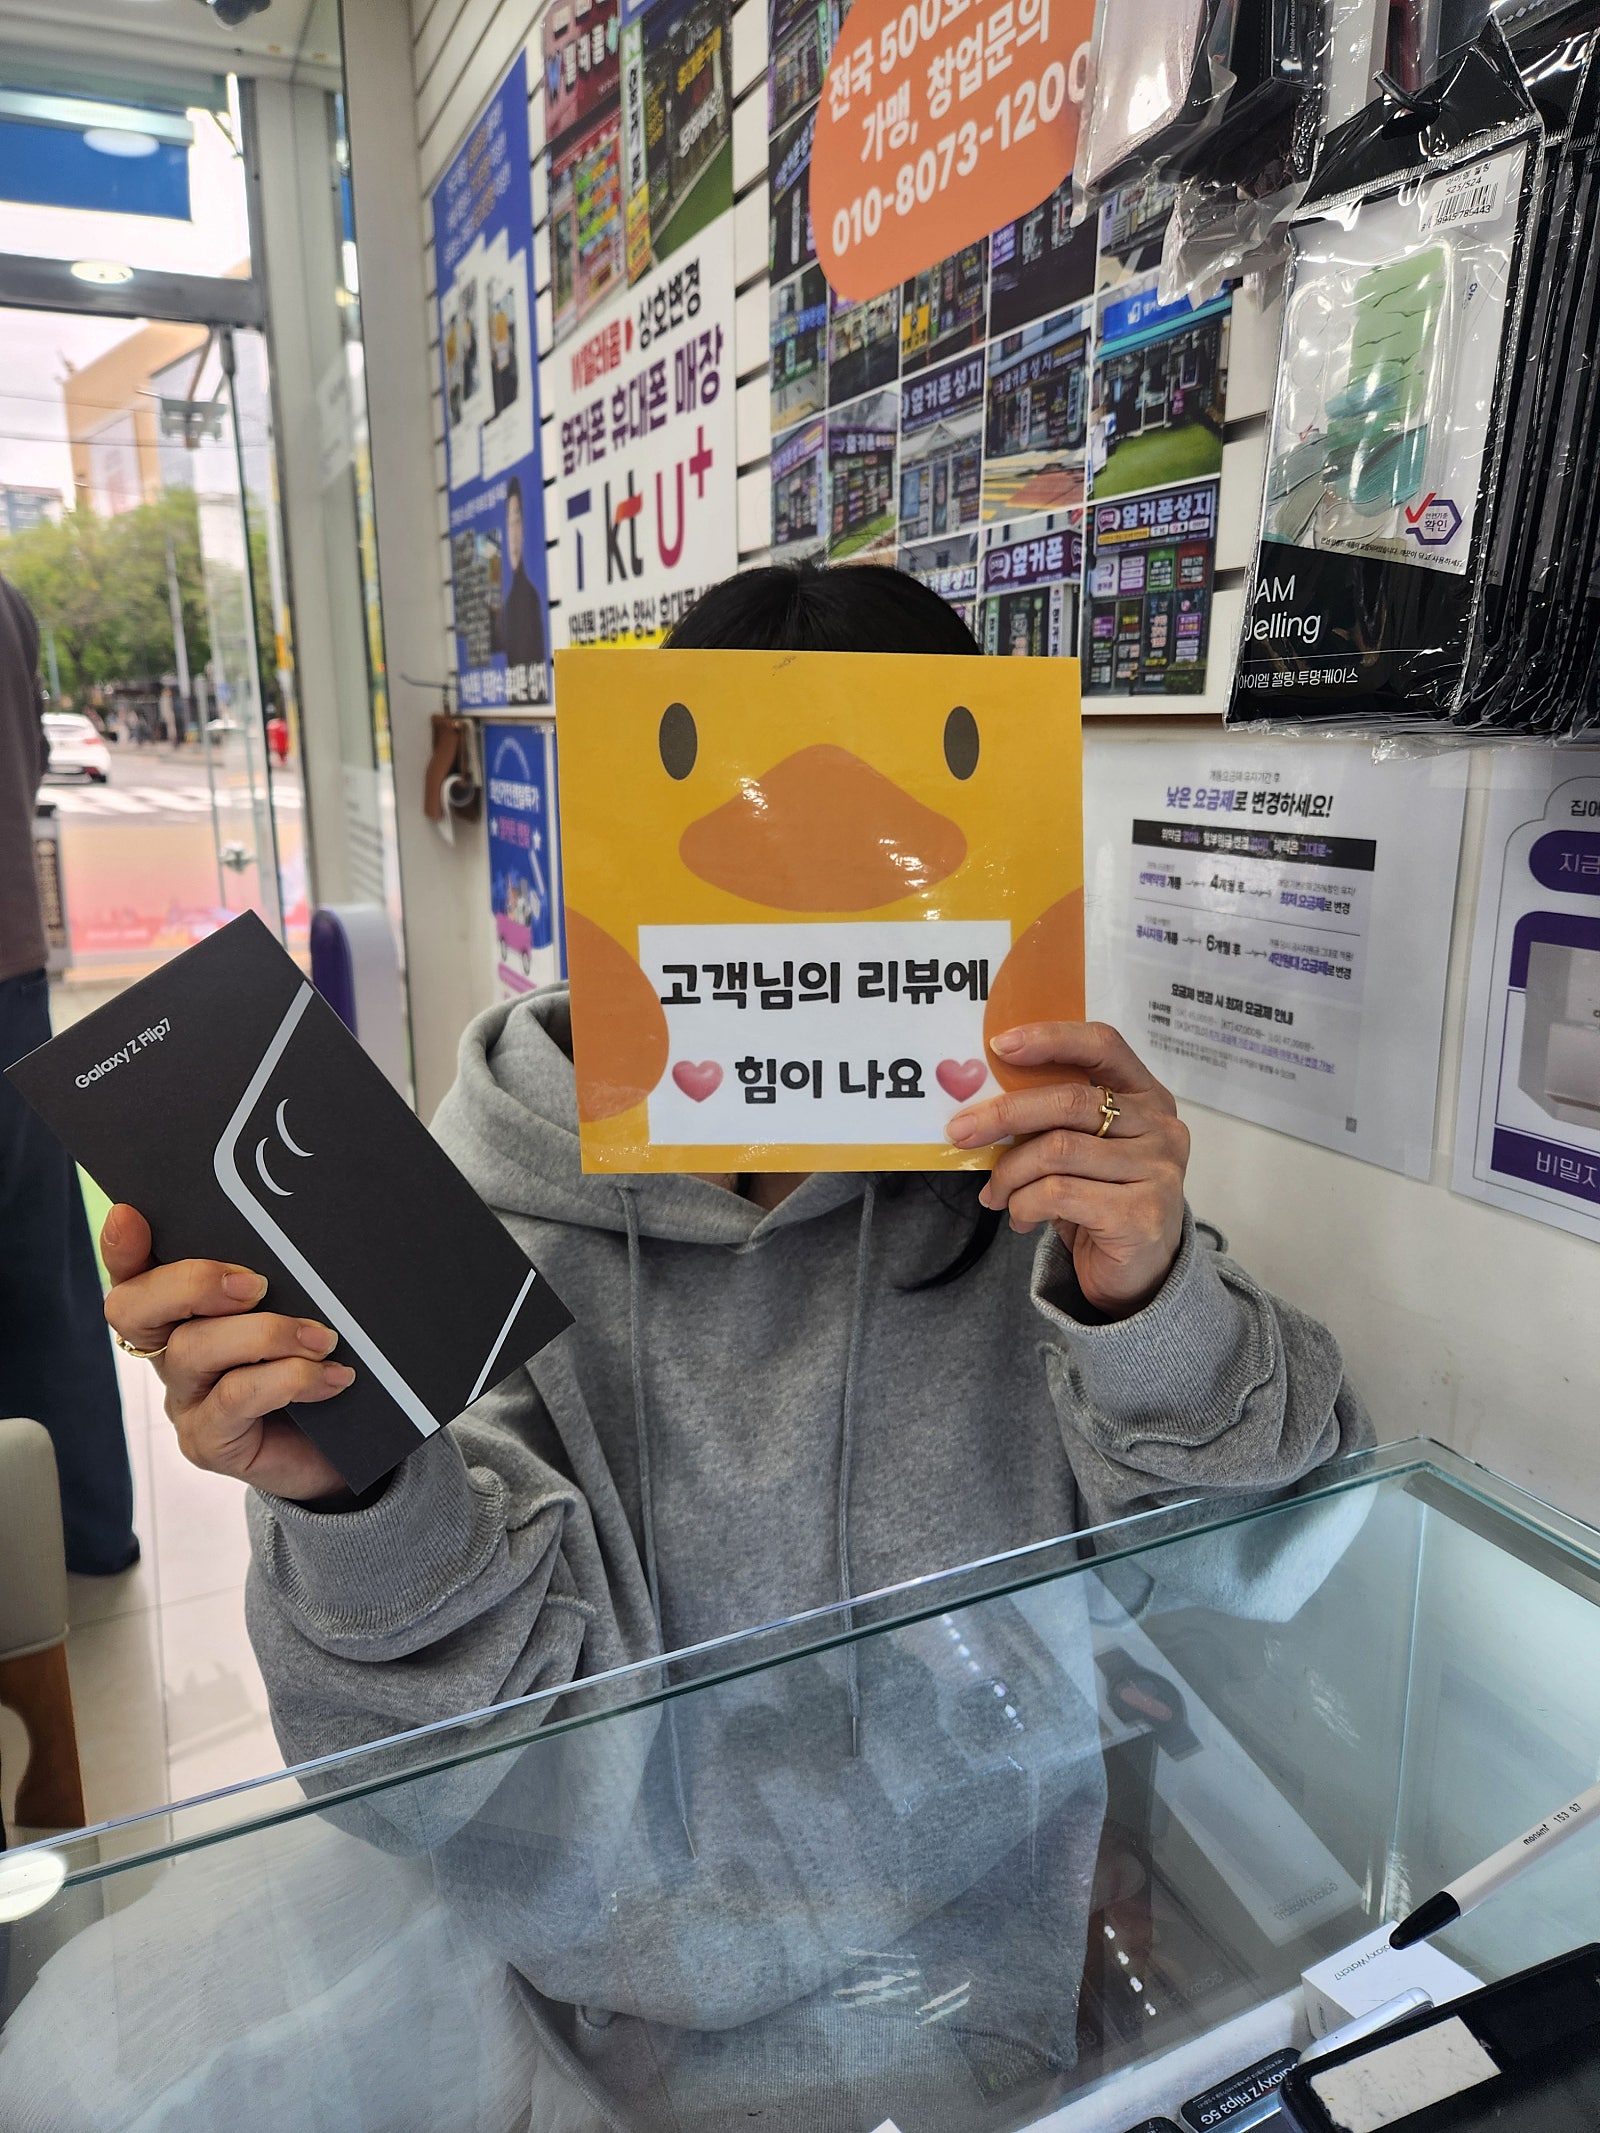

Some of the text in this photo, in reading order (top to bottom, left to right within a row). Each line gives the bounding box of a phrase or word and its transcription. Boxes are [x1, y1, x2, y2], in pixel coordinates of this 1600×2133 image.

[829, 37, 875, 124] 전국
[860, 79, 919, 163] 가맹,
[925, 0, 1051, 121] 창업문의
[831, 41, 1092, 257] 010-8073-1200
[638, 256, 701, 350] 상호변경
[561, 397, 607, 477] 옆커폰
[611, 357, 668, 452] 휴대폰
[674, 322, 724, 416] 매장
[604, 468, 645, 586] kt
[655, 424, 714, 570] U+
[1424, 519, 1448, 533] 확인
[1254, 574, 1296, 604] AM
[1244, 611, 1322, 644] Jelling
[1239, 667, 1359, 690] 아이엠 젤링 투명케이스
[1272, 772, 1281, 784] 후
[1166, 786, 1334, 819] 낮은 요금제로 변경하세요!
[1160, 828, 1182, 843] 위약금
[1558, 851, 1600, 875] 지금
[1209, 873, 1236, 894] 4개월
[1237, 880, 1245, 894] 후
[1297, 895, 1333, 913] 요금제로
[1333, 901, 1351, 915] 변경
[1206, 933, 1231, 956] 6개월
[1232, 942, 1242, 957] 후
[1300, 957, 1335, 977] 요금제로
[1335, 964, 1352, 980] 변경
[659, 958, 991, 1011] 고객님의 리뷰에
[1171, 983, 1195, 1001] 요금제
[1196, 988, 1214, 1005] 변경
[1214, 993, 1224, 1009] 시
[1244, 1001, 1273, 1021] 요금제
[1274, 1008, 1294, 1026] 안내
[75, 1017, 173, 1090] Galaxy Z Flip7
[734, 1055, 926, 1106] 힘이 나요
[1522, 1823, 1550, 1846] monami
[1552, 1810, 1571, 1824] 153
[1334, 1943, 1392, 1982] alaxy Watch7
[1247, 2086, 1262, 2099] Z
[1256, 2063, 1299, 2093] alaxy
[1200, 2108, 1223, 2127] 5G
[1219, 2091, 1253, 2115] Flip3
